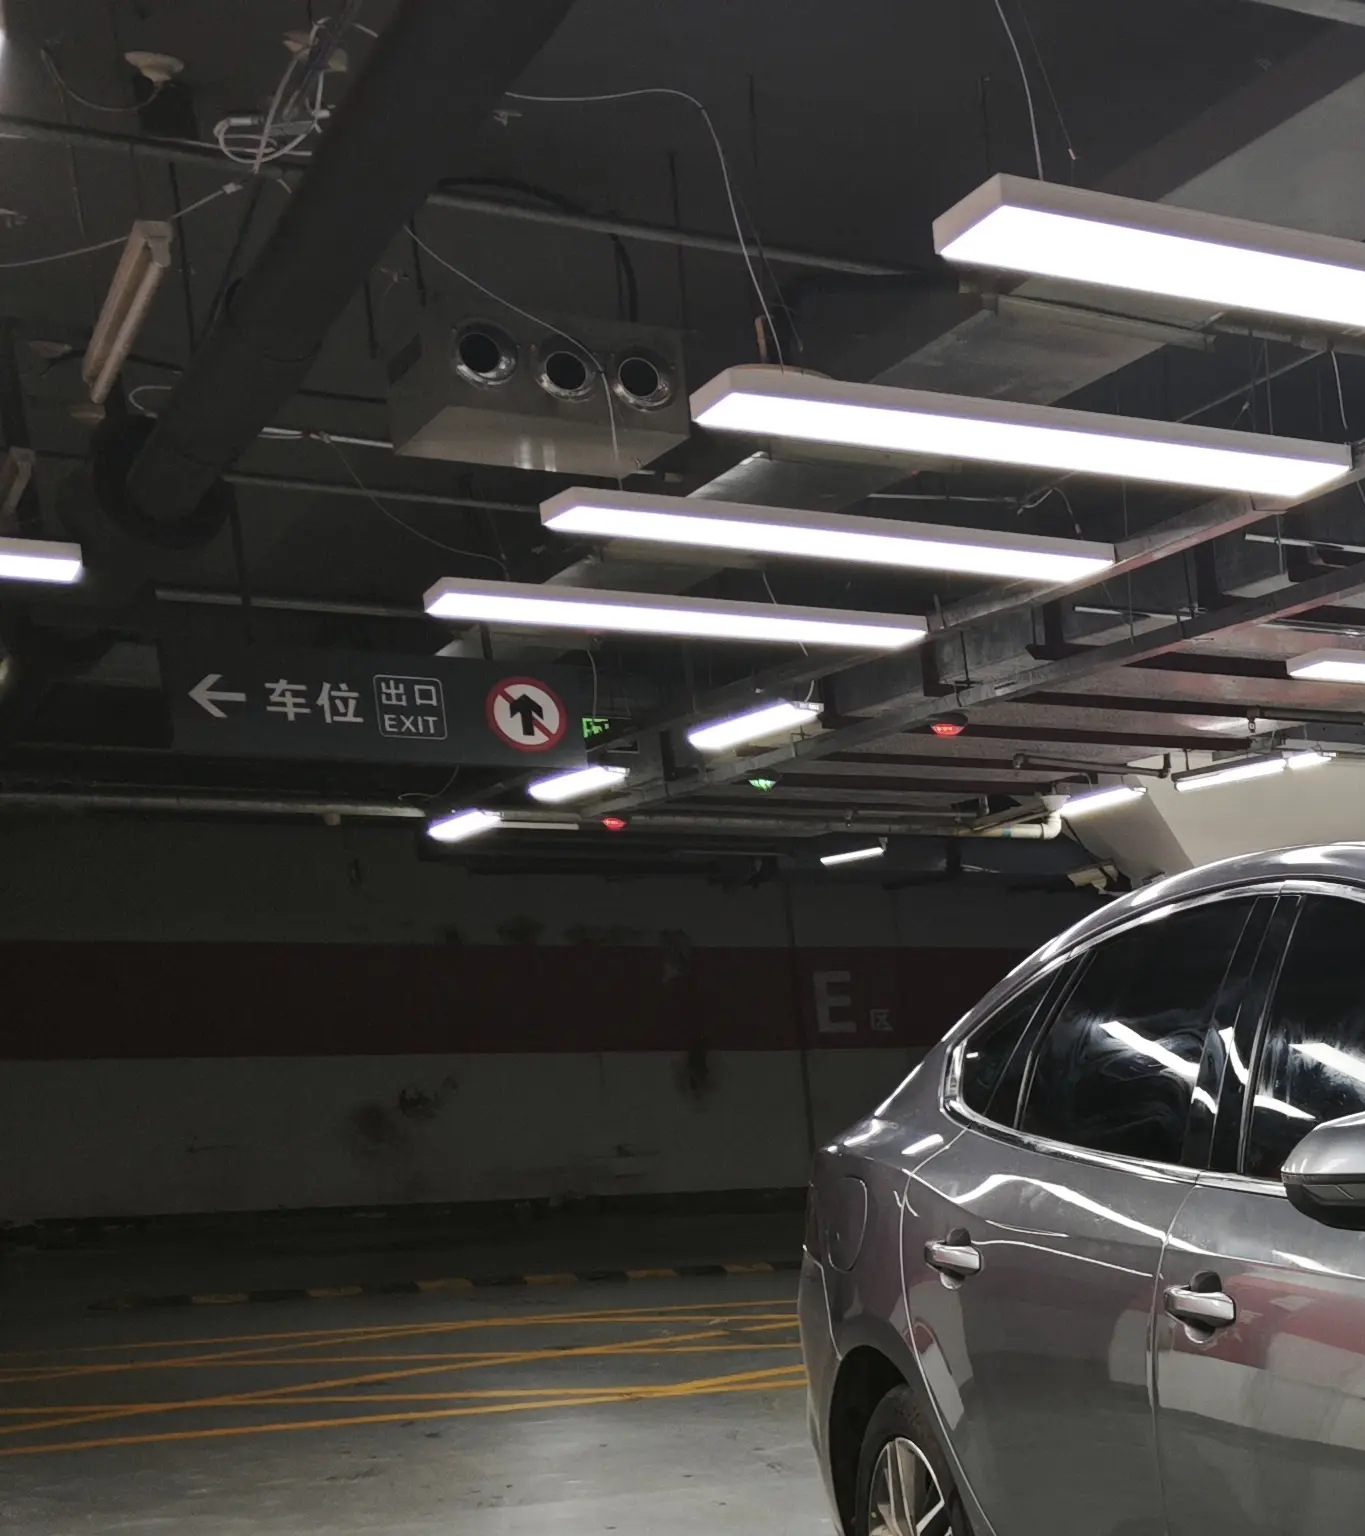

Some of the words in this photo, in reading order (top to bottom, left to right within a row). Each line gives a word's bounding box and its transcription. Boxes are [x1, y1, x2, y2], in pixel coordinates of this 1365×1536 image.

[264, 679, 364, 724] 车位
[380, 680, 439, 707] 出口
[383, 714, 439, 735] EXIT
